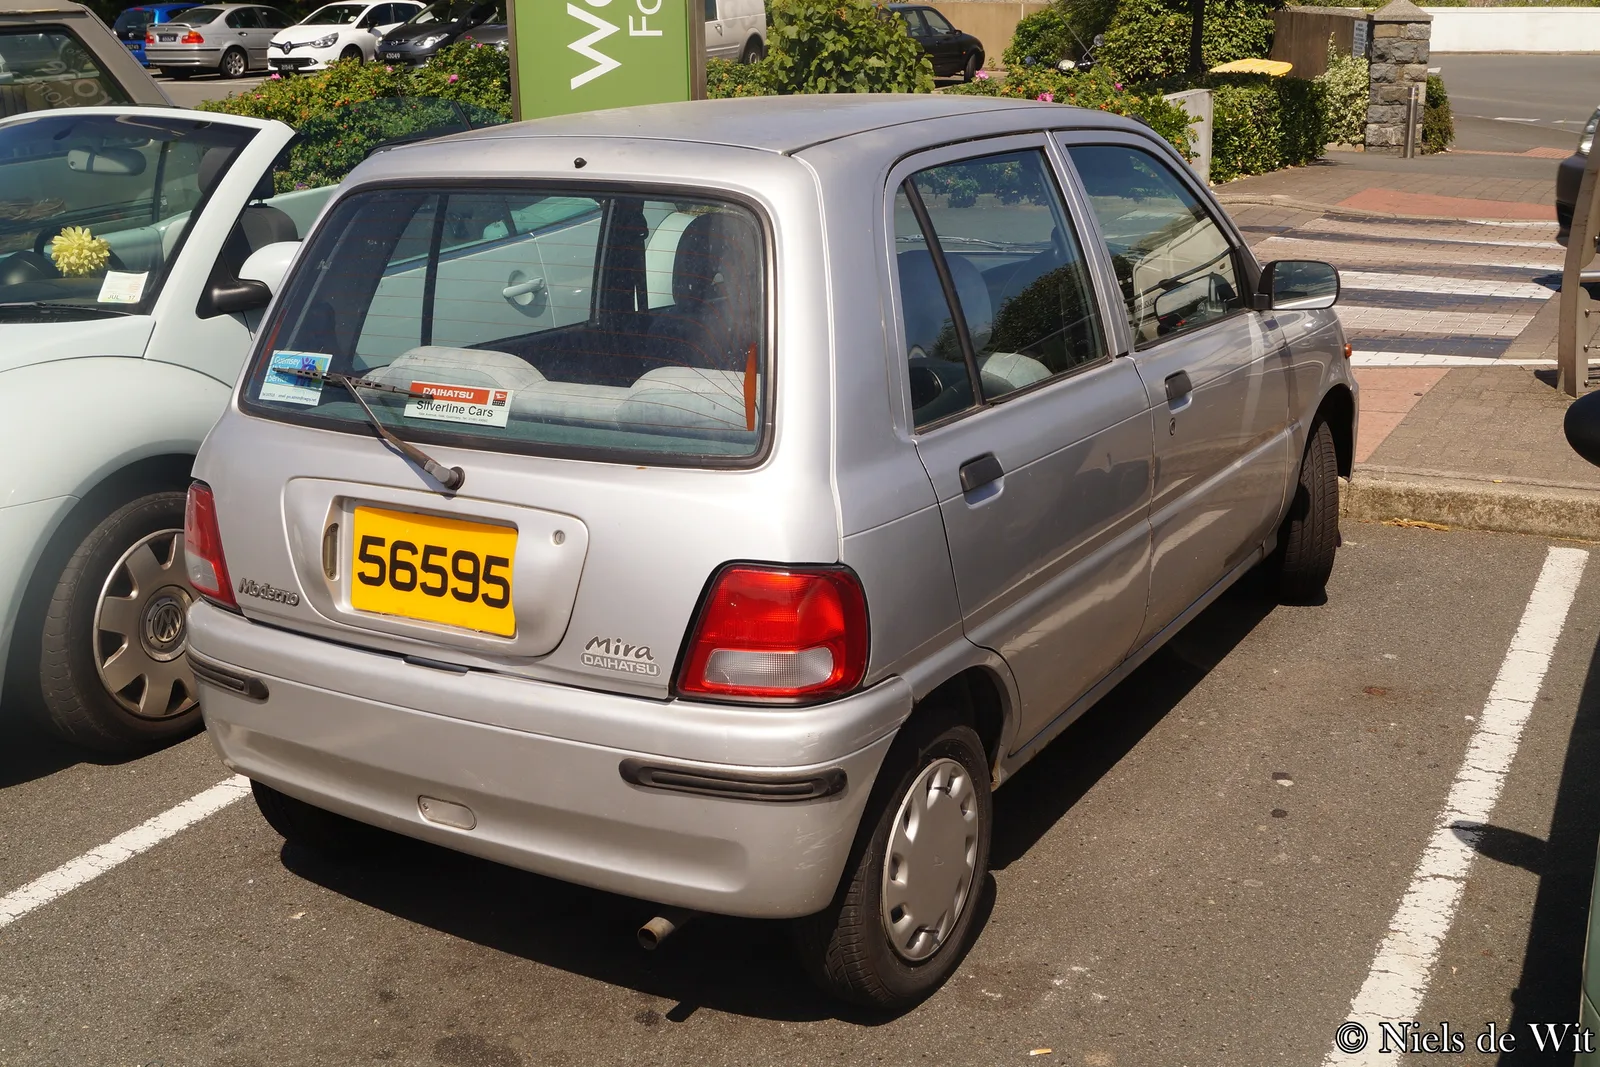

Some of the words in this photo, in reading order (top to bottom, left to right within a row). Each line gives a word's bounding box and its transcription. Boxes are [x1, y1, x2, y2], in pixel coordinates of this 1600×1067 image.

[422, 387, 475, 400] DAIHATSU
[416, 400, 466, 415] Silverline
[468, 405, 494, 418] Cars
[357, 535, 511, 610] 56595
[238, 577, 300, 607] Moderno
[585, 636, 655, 661] Mira
[583, 653, 657, 676] DAIHATSU
